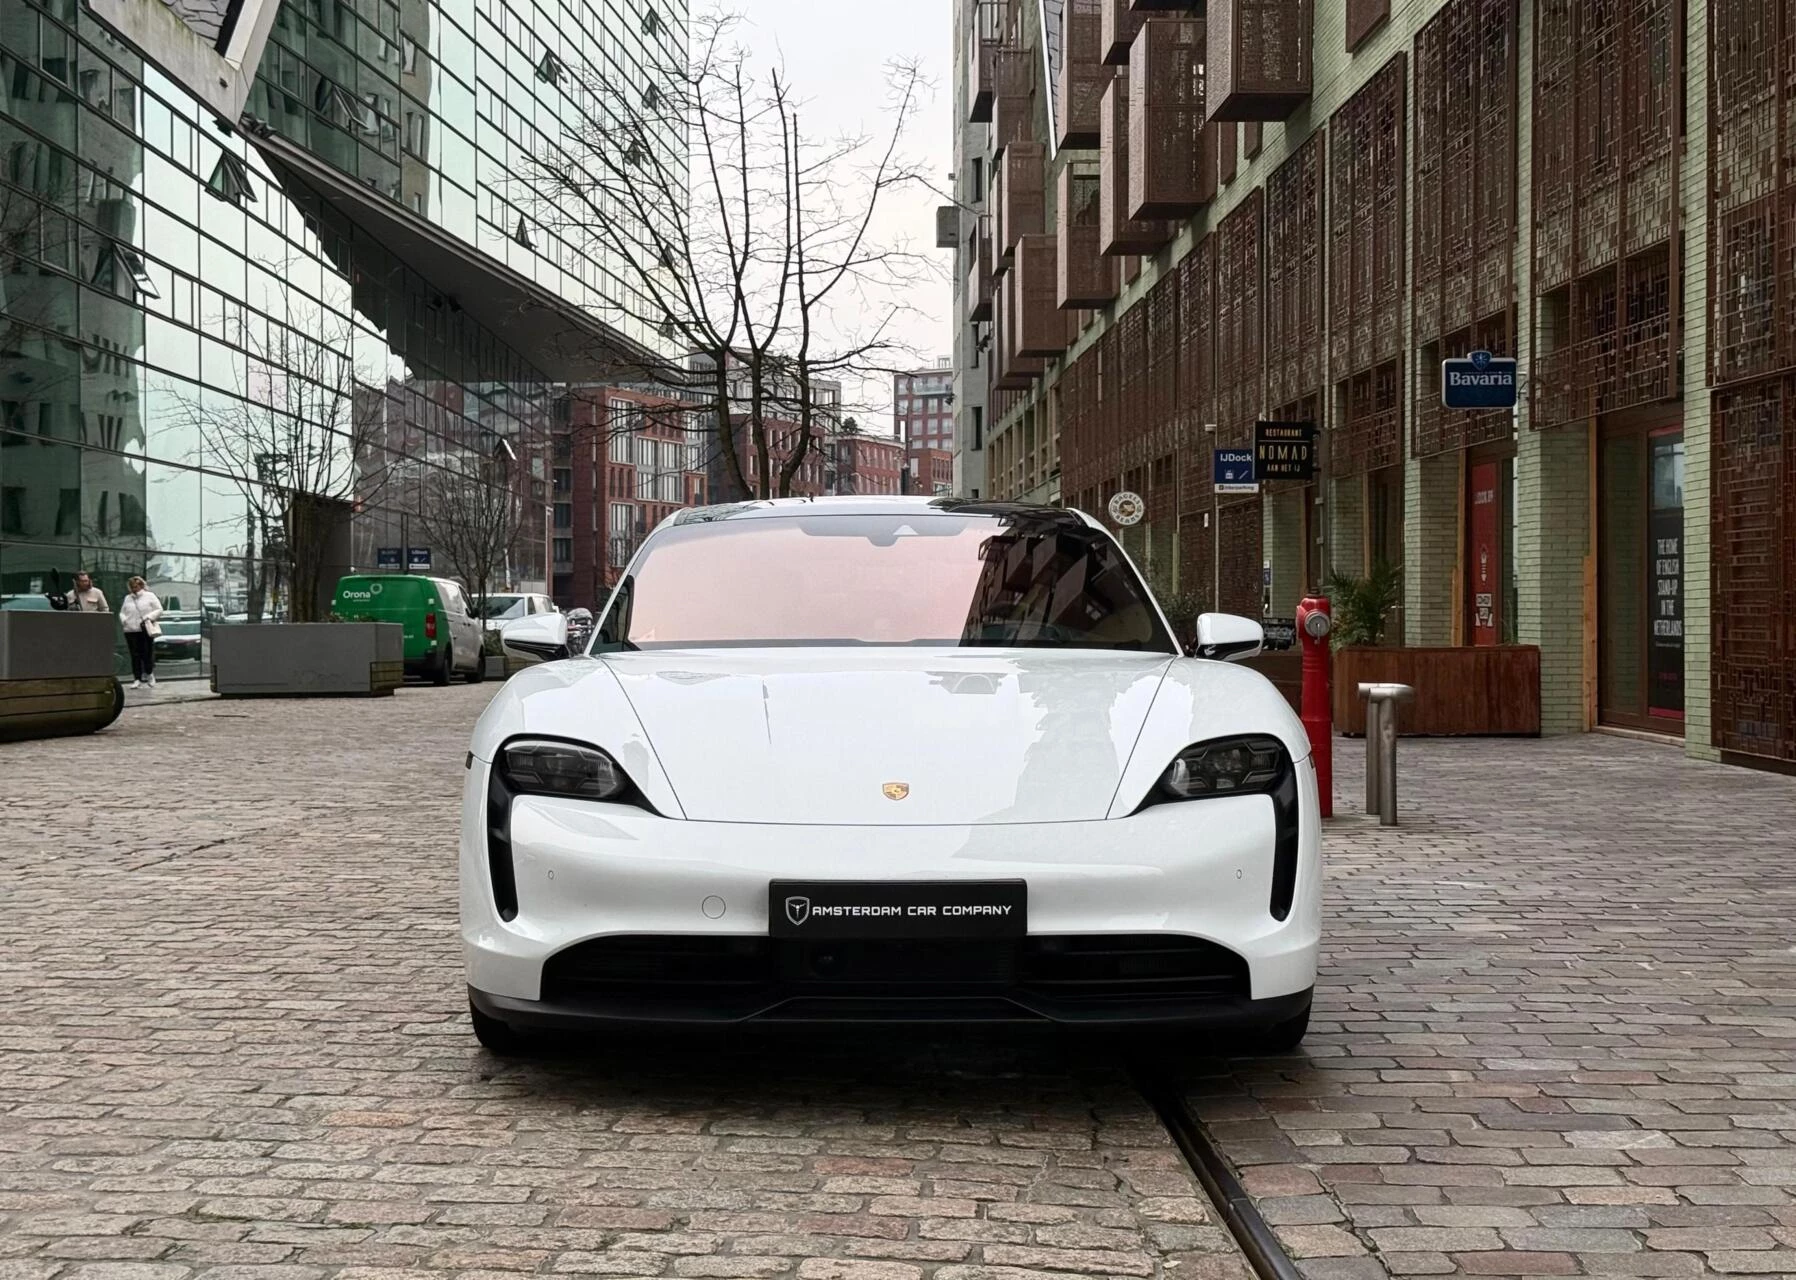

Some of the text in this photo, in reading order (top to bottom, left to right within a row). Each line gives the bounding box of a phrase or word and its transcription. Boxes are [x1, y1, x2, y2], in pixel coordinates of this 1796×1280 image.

[1449, 371, 1513, 386] Bavaria
[1265, 428, 1302, 438] RESTAURANT
[1220, 453, 1252, 462] IJDock
[1259, 445, 1308, 461] NOMAD
[1266, 463, 1301, 473] AAN HET IJ
[342, 590, 371, 599] Orona
[812, 905, 1012, 916] AMSTERDAM CAR COMPANY
